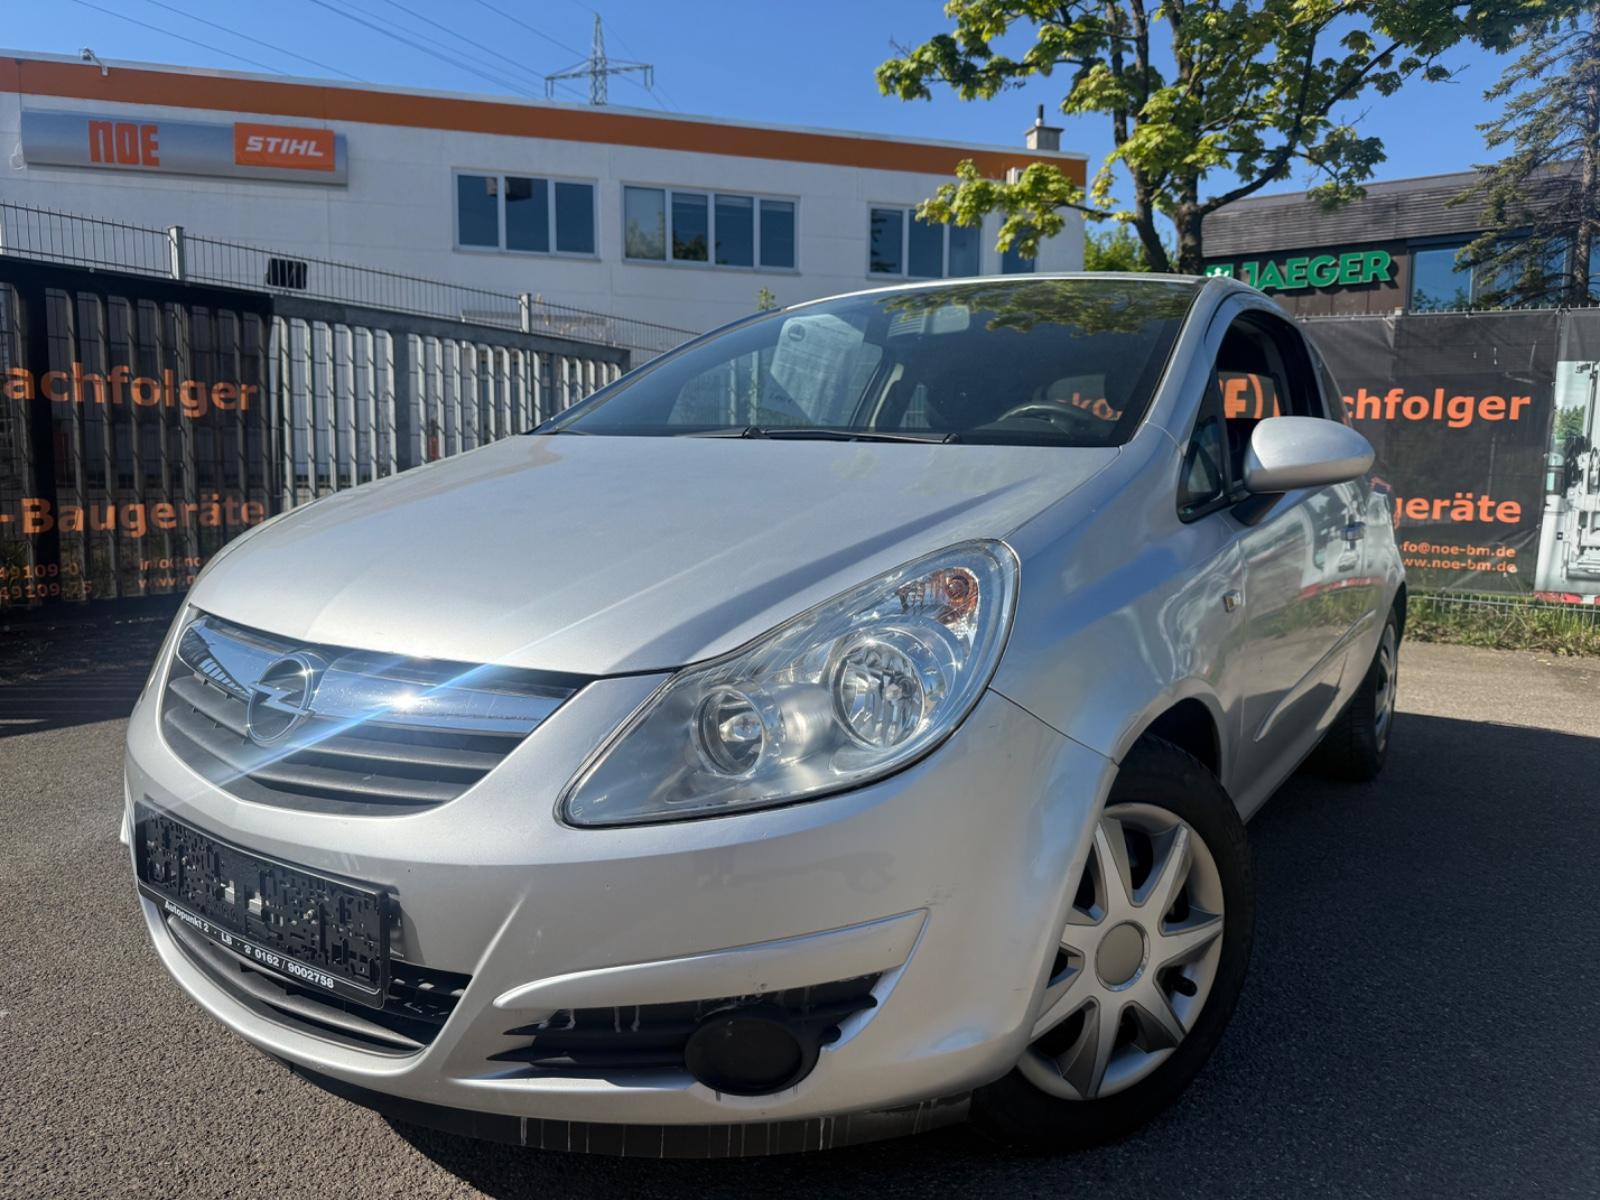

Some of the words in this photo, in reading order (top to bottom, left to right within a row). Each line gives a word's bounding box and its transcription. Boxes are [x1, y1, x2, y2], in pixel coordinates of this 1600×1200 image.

[88, 120, 160, 167] NOE
[245, 135, 323, 157] STIHL
[1242, 250, 1392, 291] JAEGER
[165, 900, 202, 929] Autopunkt
[255, 949, 280, 968] 0162
[287, 962, 334, 989] 9002758
